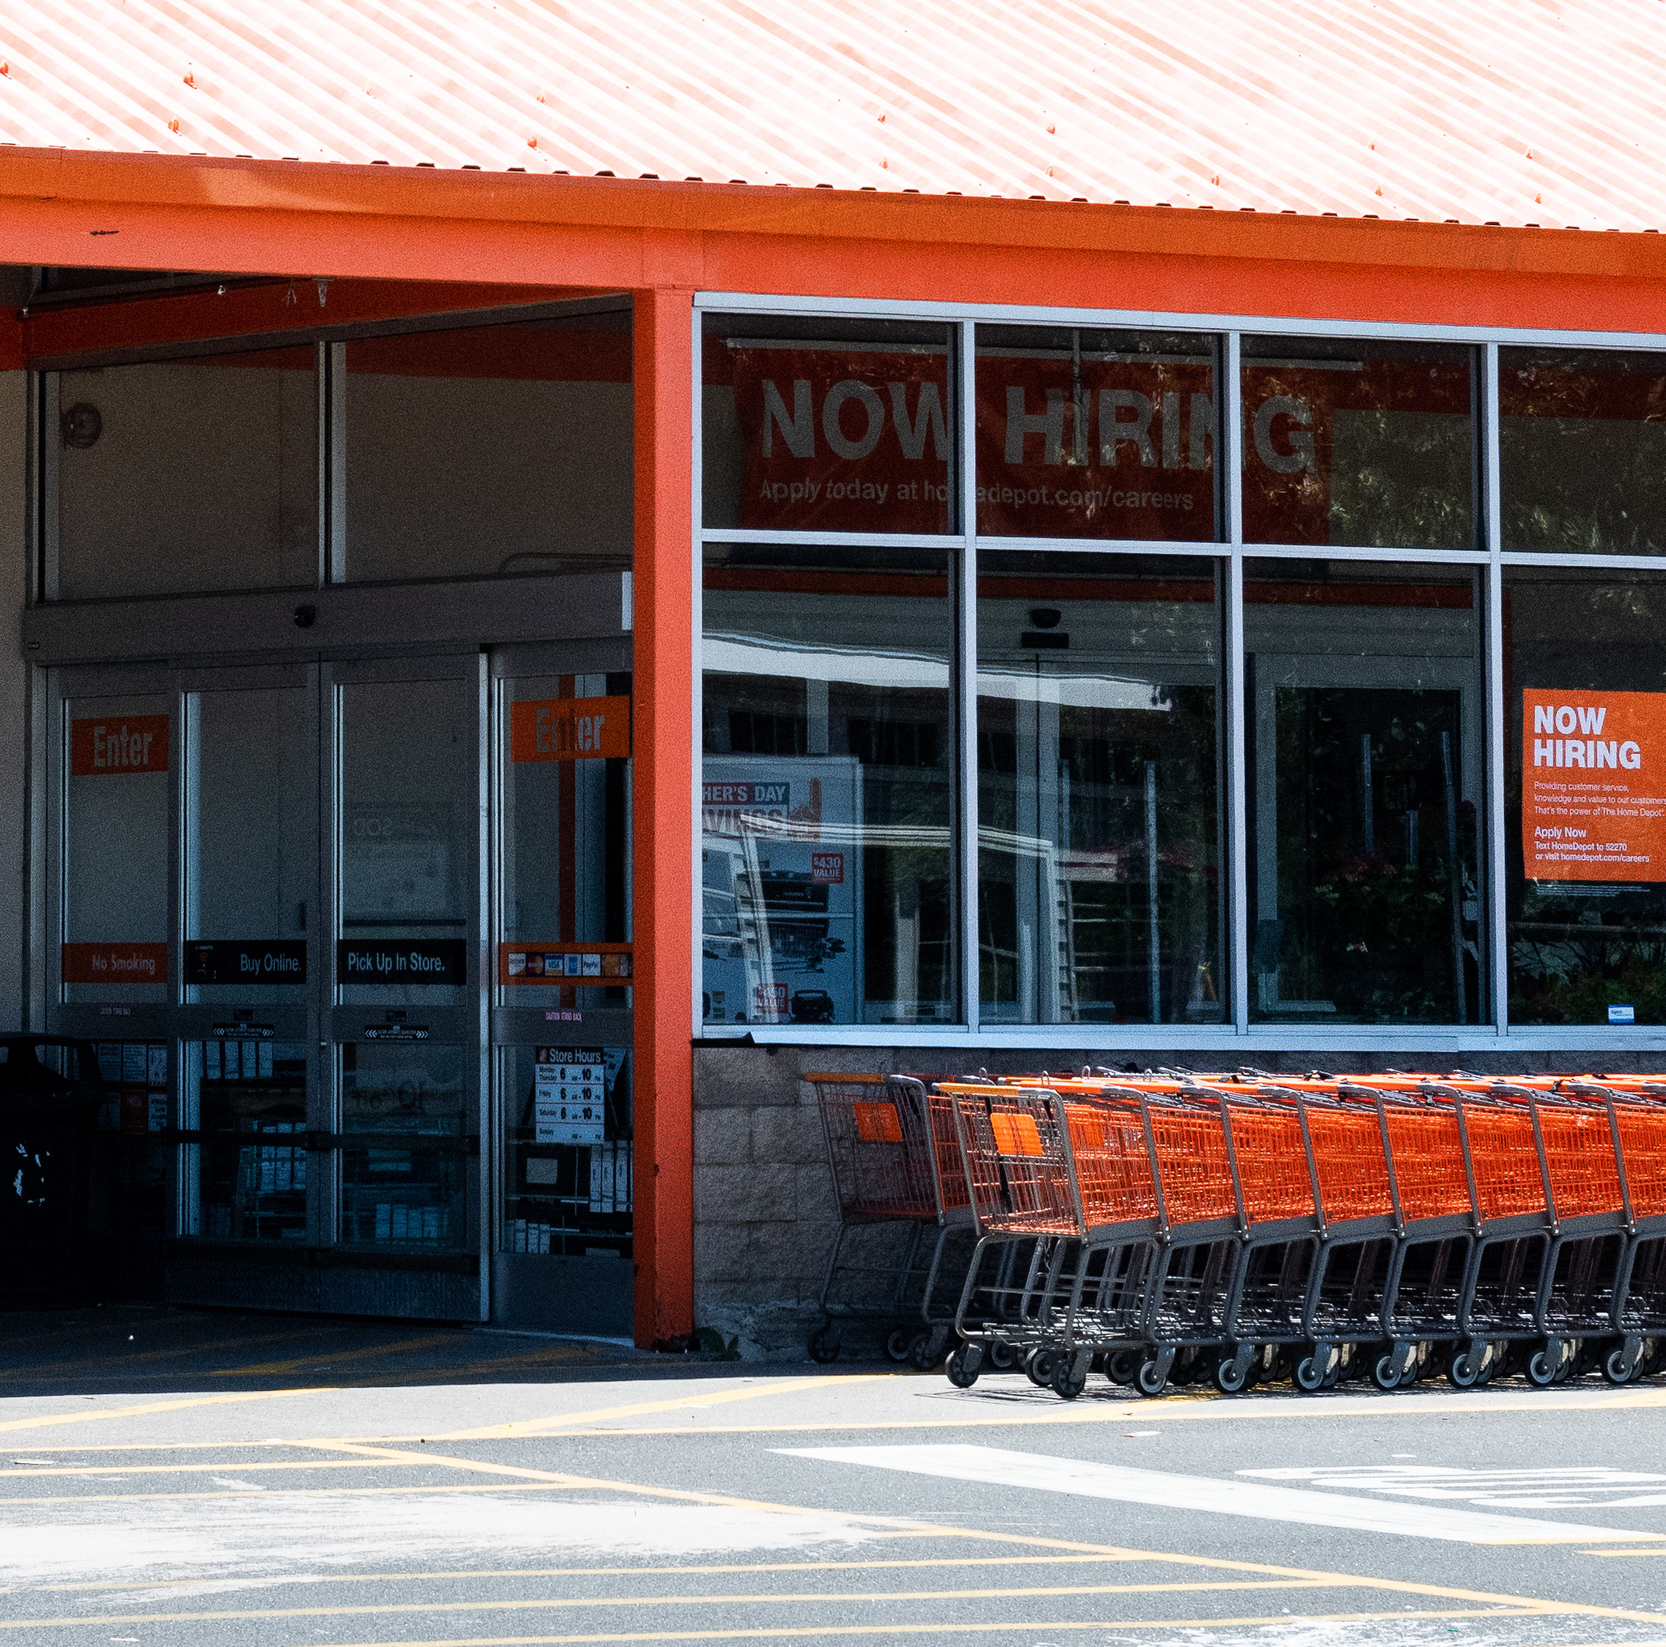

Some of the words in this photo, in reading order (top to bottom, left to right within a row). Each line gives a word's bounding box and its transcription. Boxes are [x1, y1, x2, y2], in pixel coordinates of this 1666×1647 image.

[761, 379, 948, 461] NOW
[760, 477, 821, 503] Apply
[826, 478, 889, 504] today
[897, 480, 918, 500] at
[924, 480, 1194, 510] hoedepot.com/careers
[1534, 705, 1606, 735] NOW
[536, 708, 605, 753] Enter
[93, 725, 153, 768] Enter
[1534, 739, 1641, 769] HIRING
[755, 786, 786, 801] DAY
[1534, 781, 1566, 792] Providing
[1568, 782, 1600, 791] customer
[1603, 784, 1629, 792] service,
[1534, 794, 1571, 804] knowledge
[1535, 806, 1555, 814] That's
[1602, 808, 1615, 816] The
[1535, 826, 1562, 839] Apply
[1565, 827, 1586, 837] Now
[1535, 841, 1550, 850] Text
[1552, 842, 1594, 851] HomeDepot
[1606, 843, 1627, 851] 52270
[1561, 853, 1649, 863] homedepot.com/careers
[814, 869, 841, 877] VALUE
[92, 954, 107, 970] No
[110, 954, 155, 975] Smoking
[240, 954, 260, 976] Buy
[264, 953, 301, 973] Online.
[348, 952, 373, 971] Pick
[376, 953, 391, 974] Up
[396, 953, 406, 971] In
[410, 953, 445, 971] Store.
[549, 1048, 573, 1063] Store
[575, 1048, 601, 1063] Hours
[560, 1068, 565, 1079] 6
[582, 1069, 591, 1080] 10
[560, 1088, 566, 1100] 6
[582, 1088, 591, 1099] 10
[561, 1108, 566, 1119] 6
[583, 1108, 592, 1119] 10
